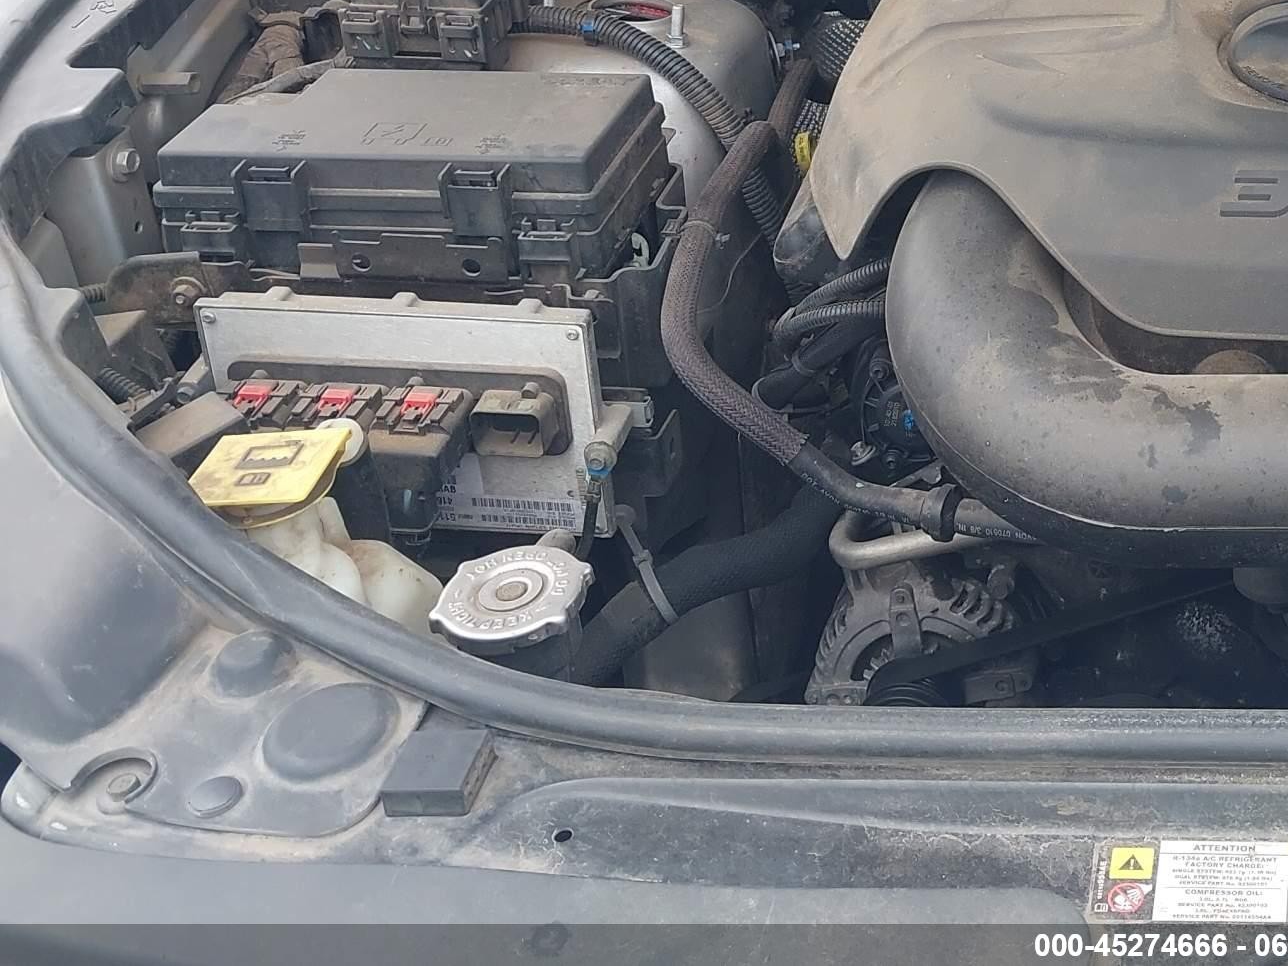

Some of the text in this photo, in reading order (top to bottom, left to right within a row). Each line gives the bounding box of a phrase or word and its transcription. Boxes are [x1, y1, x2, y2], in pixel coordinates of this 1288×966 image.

[501, 551, 548, 564] OPEN
[448, 601, 534, 630] KEEP TIGHT
[1193, 844, 1256, 852] ATTENTION
